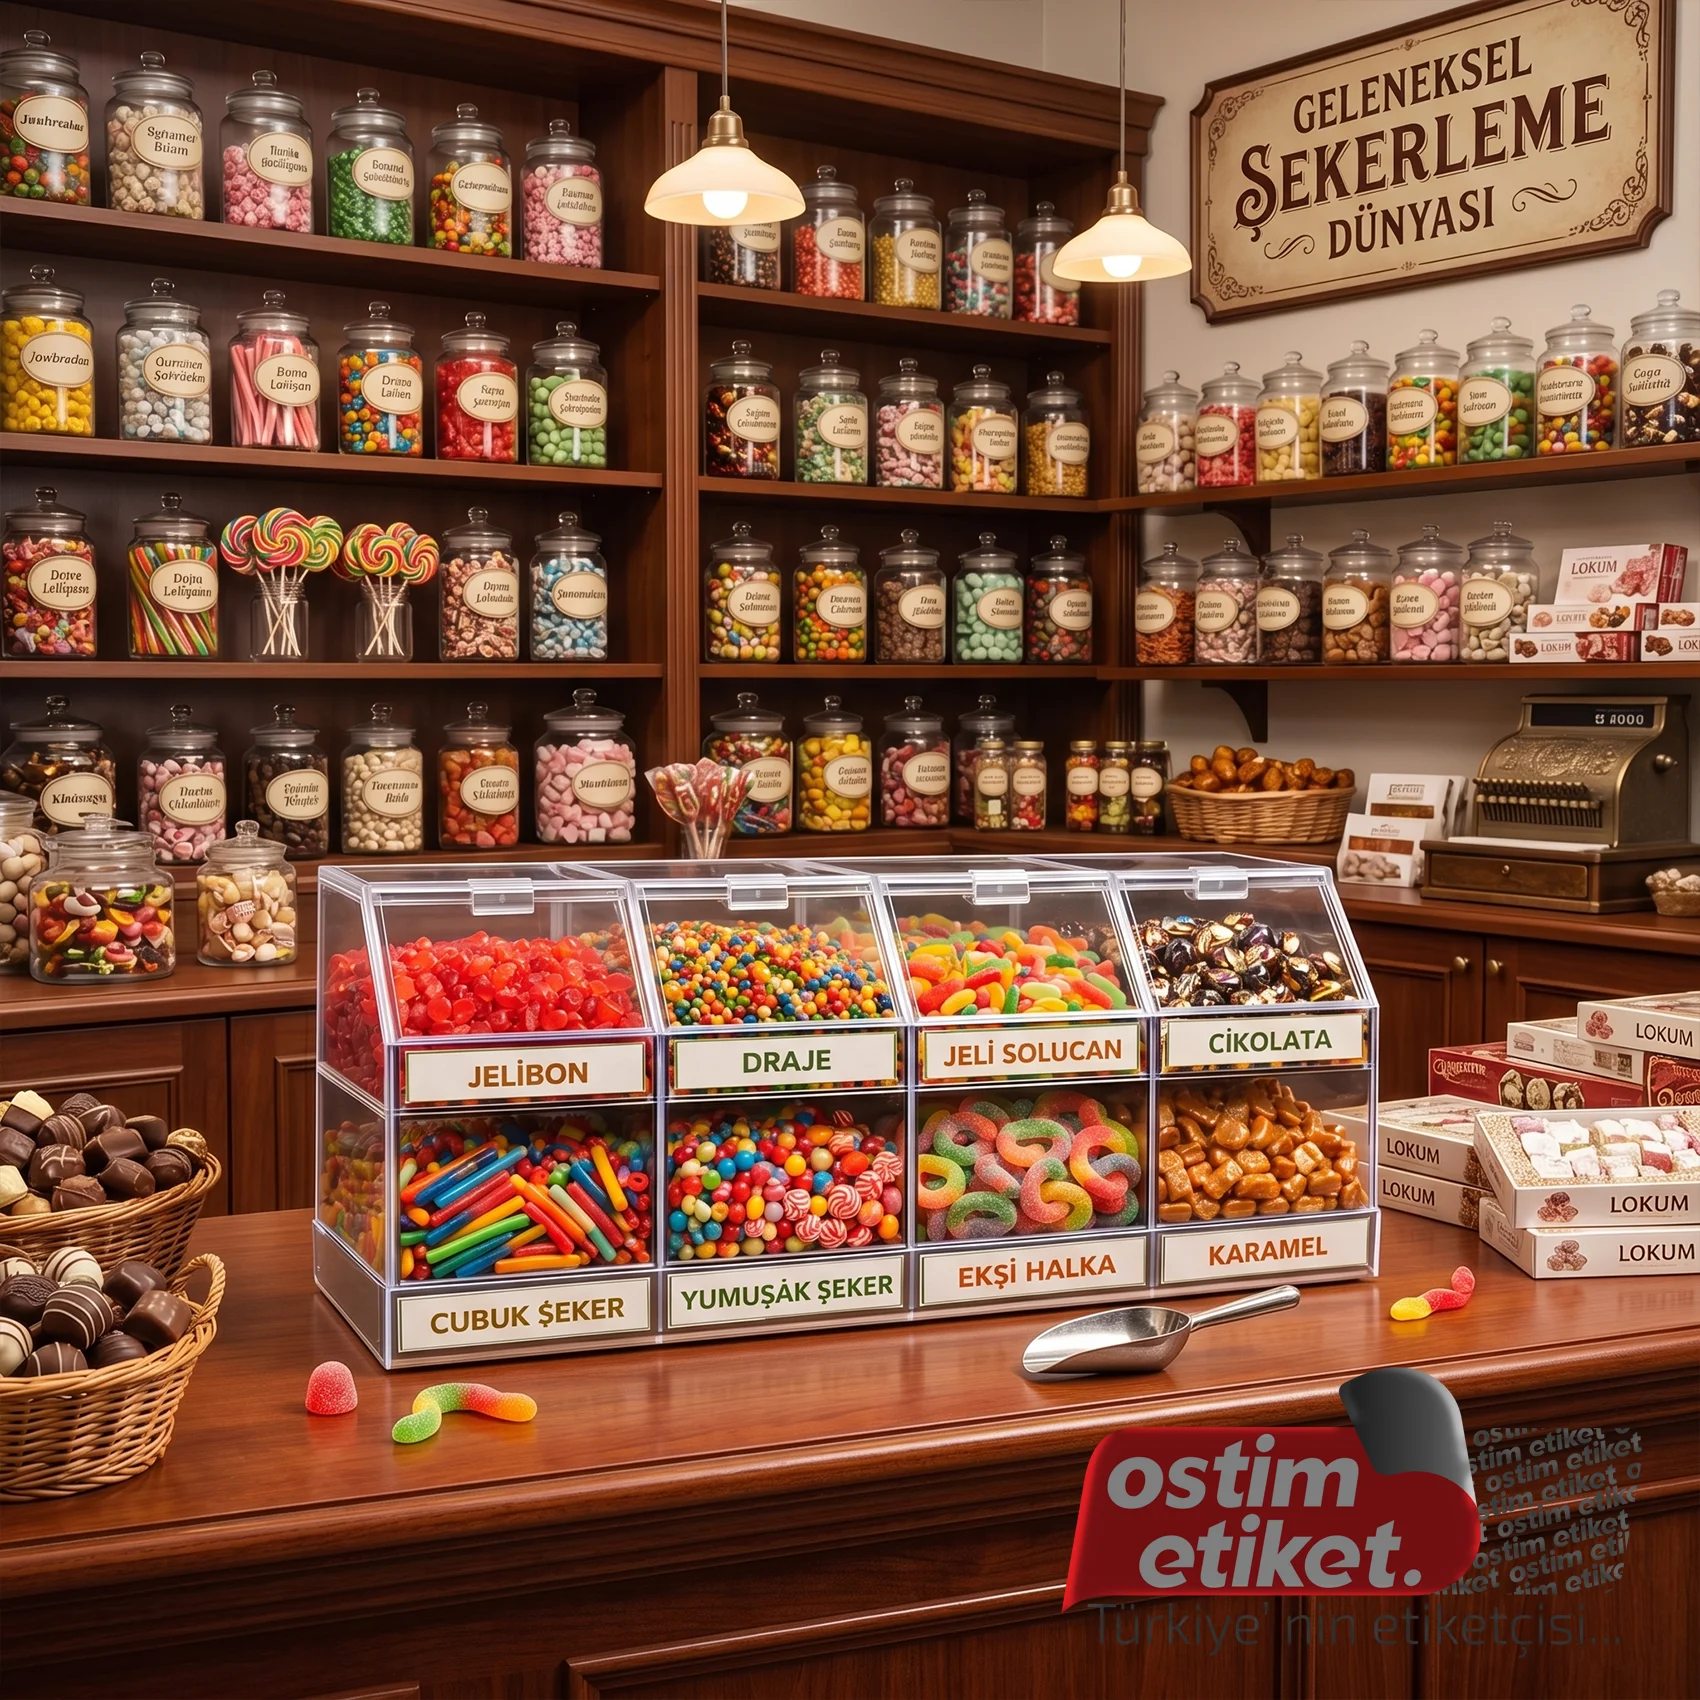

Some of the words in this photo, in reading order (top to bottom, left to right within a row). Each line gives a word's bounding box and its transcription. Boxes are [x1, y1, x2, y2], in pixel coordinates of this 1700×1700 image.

[1293, 35, 1532, 134] GELENEKSEL
[1235, 73, 1611, 243] ŞEKERLEME
[1328, 186, 1495, 259] DÜNYASI
[1571, 560, 1618, 575] LOKUM
[1208, 1027, 1332, 1054] CİKOLATA
[1636, 1022, 1693, 1047] LOKUM
[743, 1049, 832, 1074] DRAJE
[944, 1040, 994, 1068] JELİ
[1002, 1038, 1122, 1063] SOLUCAN
[468, 1058, 588, 1089] JELİBON
[1386, 1137, 1440, 1165] LOKUM
[1382, 1178, 1435, 1207] LOKUM
[1610, 1194, 1689, 1214] LOKUM
[1208, 1236, 1328, 1267] KARAMEL
[1618, 1243, 1695, 1262] LOKUM
[958, 1258, 1017, 1290] EKŞİ
[1025, 1254, 1116, 1282] HALKA
[817, 1274, 894, 1304] ŞEKER
[429, 1303, 529, 1334] CUBUK
